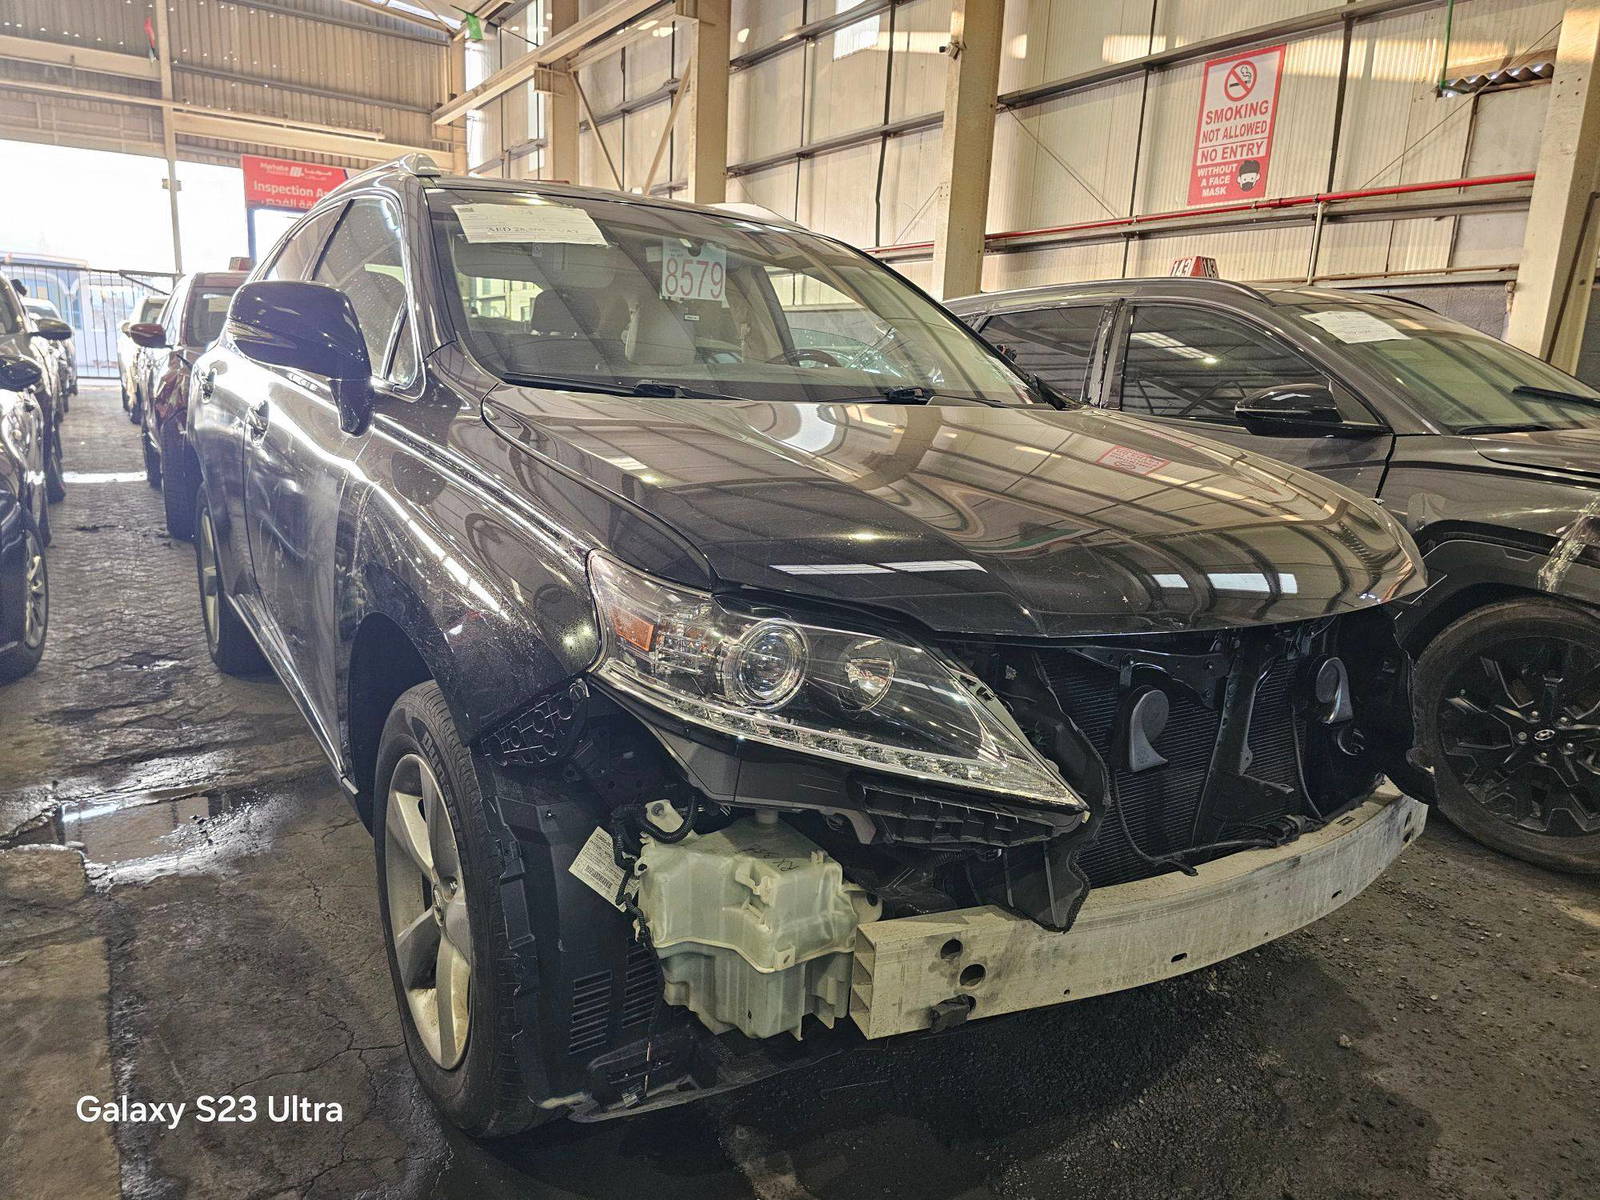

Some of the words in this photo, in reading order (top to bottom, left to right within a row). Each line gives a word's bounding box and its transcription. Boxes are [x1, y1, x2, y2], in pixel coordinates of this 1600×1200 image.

[1205, 99, 1269, 125] SMOKING
[1201, 127, 1220, 144] NOT
[1222, 120, 1268, 140] ALLOWED
[1200, 148, 1218, 163] NO
[1221, 140, 1265, 160] ENTRY
[1197, 163, 1238, 177] WITHOUT
[253, 180, 314, 198] Inspection
[1200, 178, 1207, 187] A
[1208, 175, 1231, 186] FACE
[1201, 186, 1227, 197] MASK
[665, 258, 724, 299] 8579
